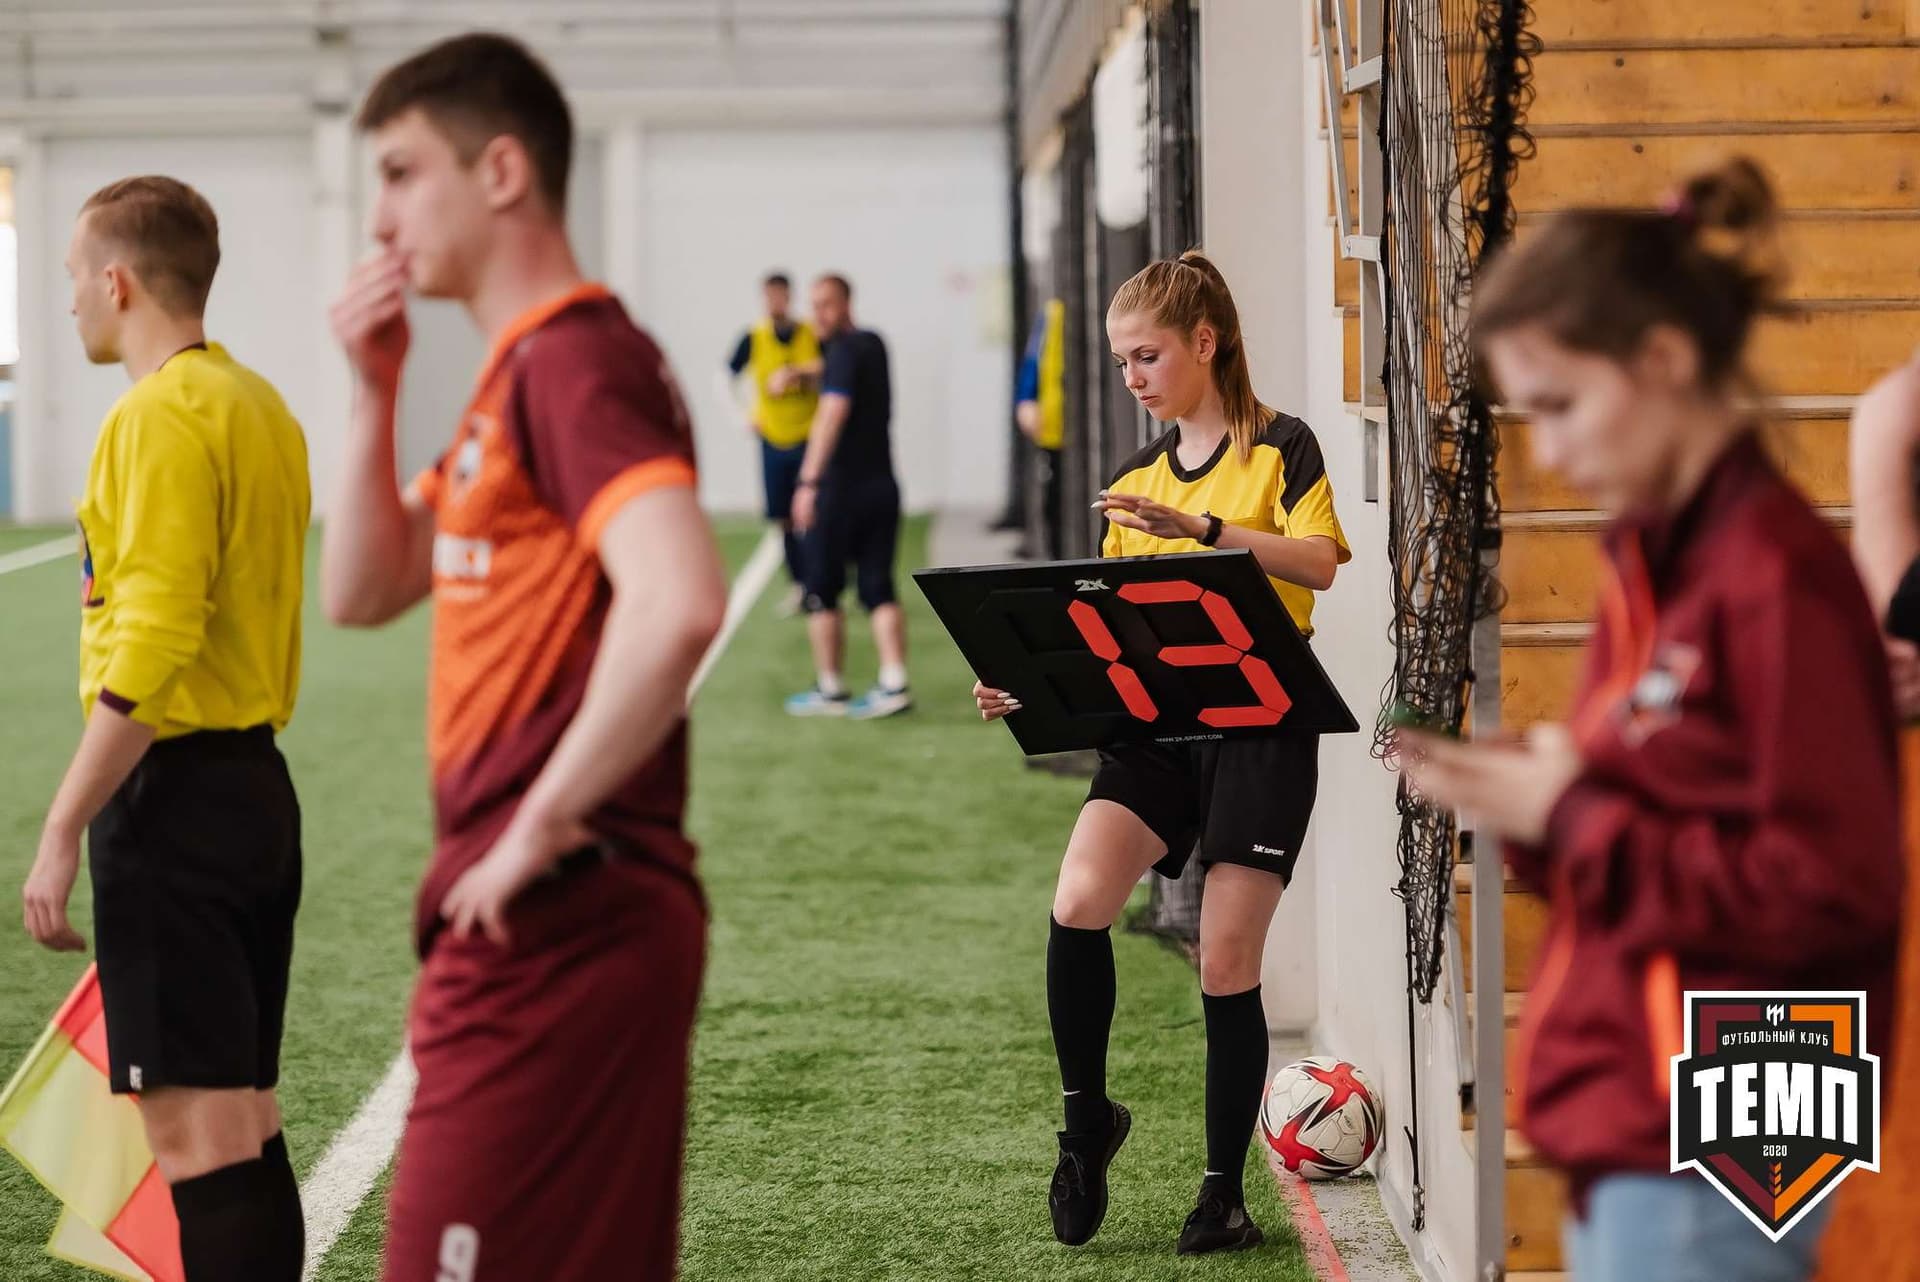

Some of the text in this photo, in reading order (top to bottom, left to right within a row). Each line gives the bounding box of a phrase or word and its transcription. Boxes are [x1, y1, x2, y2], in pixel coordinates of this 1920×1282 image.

[1074, 578, 1111, 591] 2K
[1067, 580, 1292, 728] 13
[1252, 843, 1286, 857] 2K SPORT
